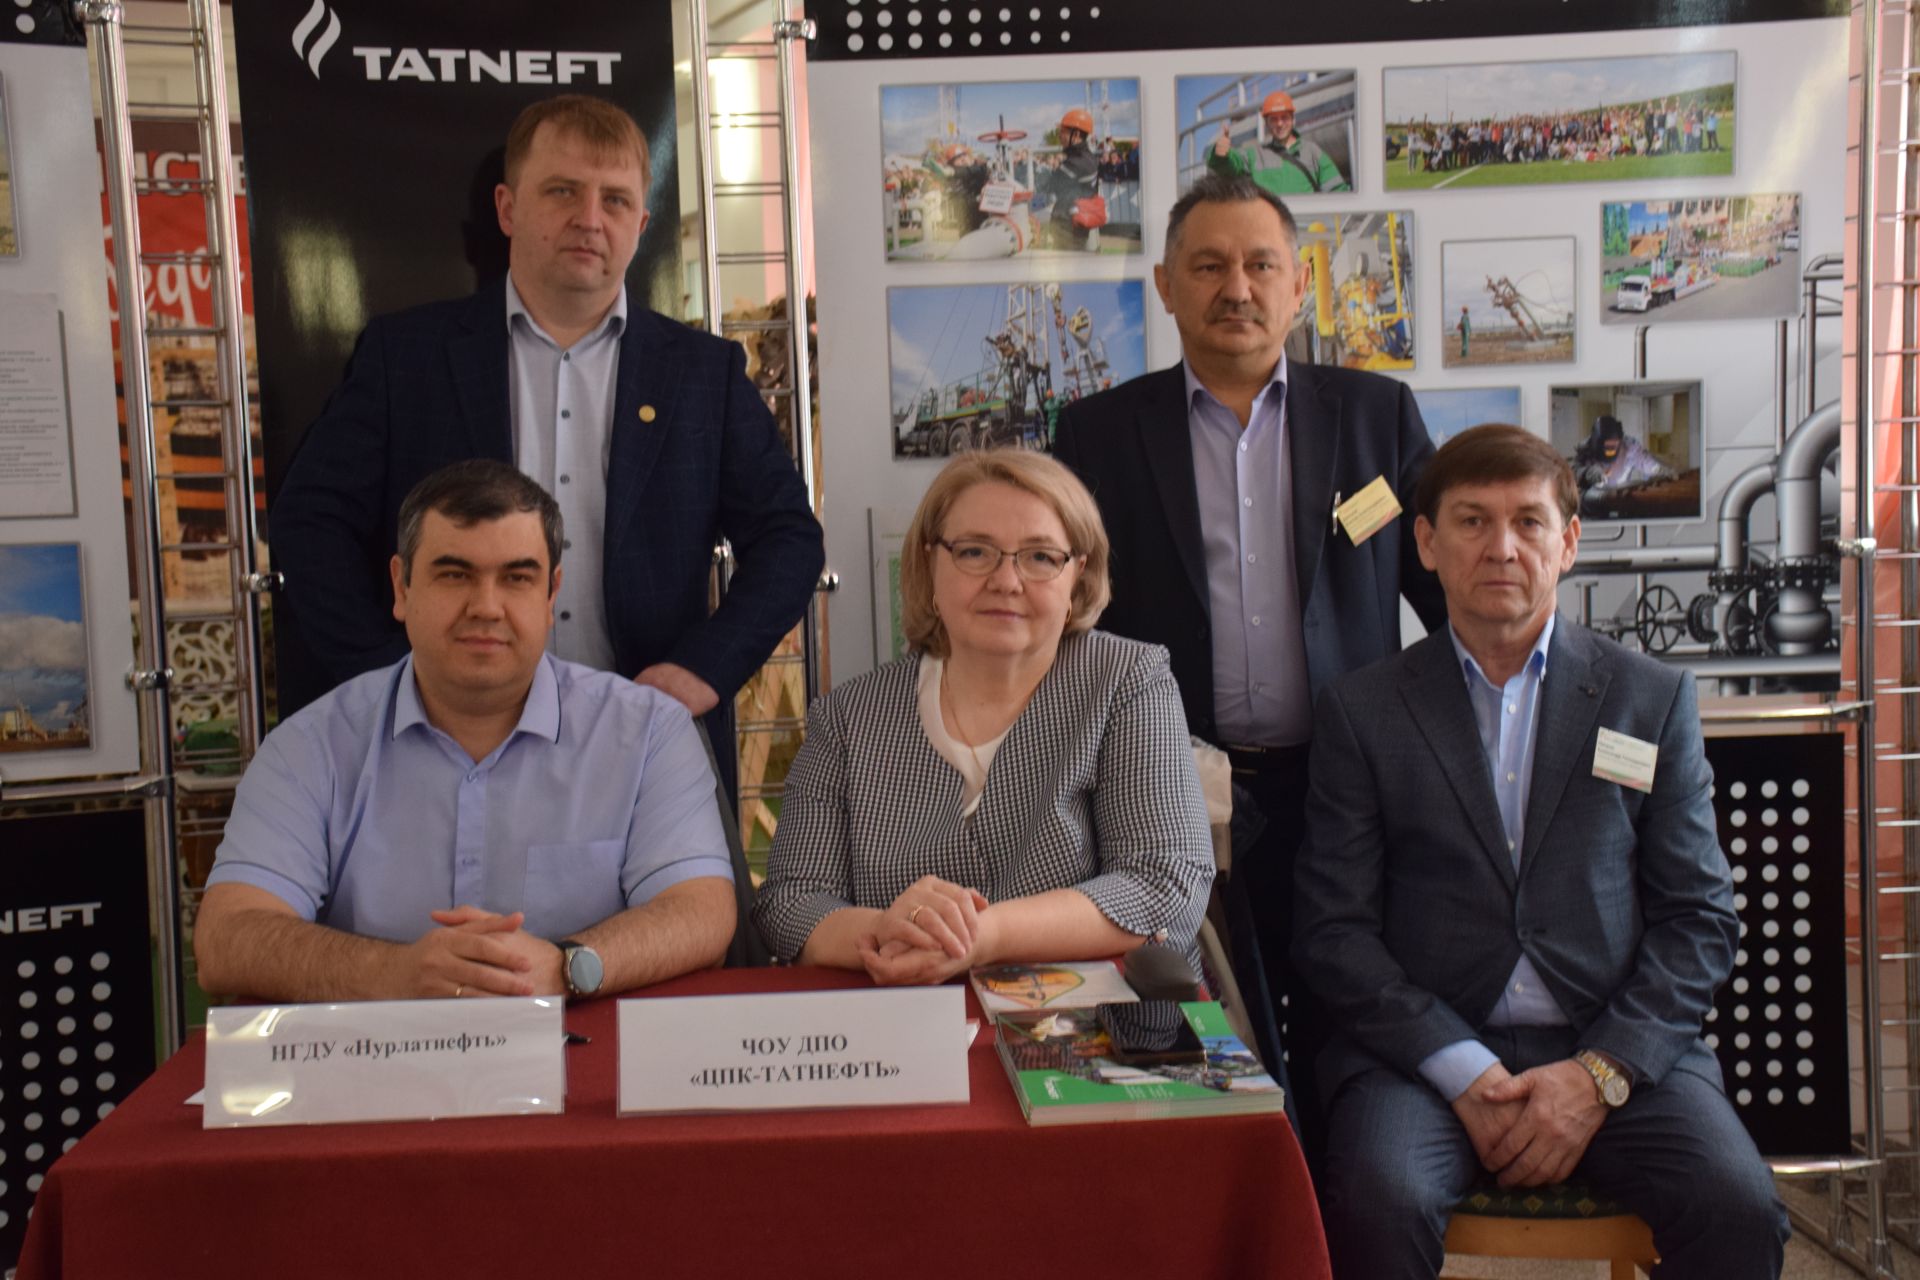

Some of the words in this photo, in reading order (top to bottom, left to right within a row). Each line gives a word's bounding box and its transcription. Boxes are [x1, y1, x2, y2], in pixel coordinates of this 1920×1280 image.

[353, 46, 622, 85] TATNEFT
[271, 1040, 337, 1063] НГДУ
[343, 1032, 508, 1060] «Нурлатнефть»
[742, 1036, 791, 1056] ЧОУ
[797, 1033, 848, 1056] ДПО
[689, 1060, 900, 1088] «ЦПК-ТАТНЕФТЬ»
